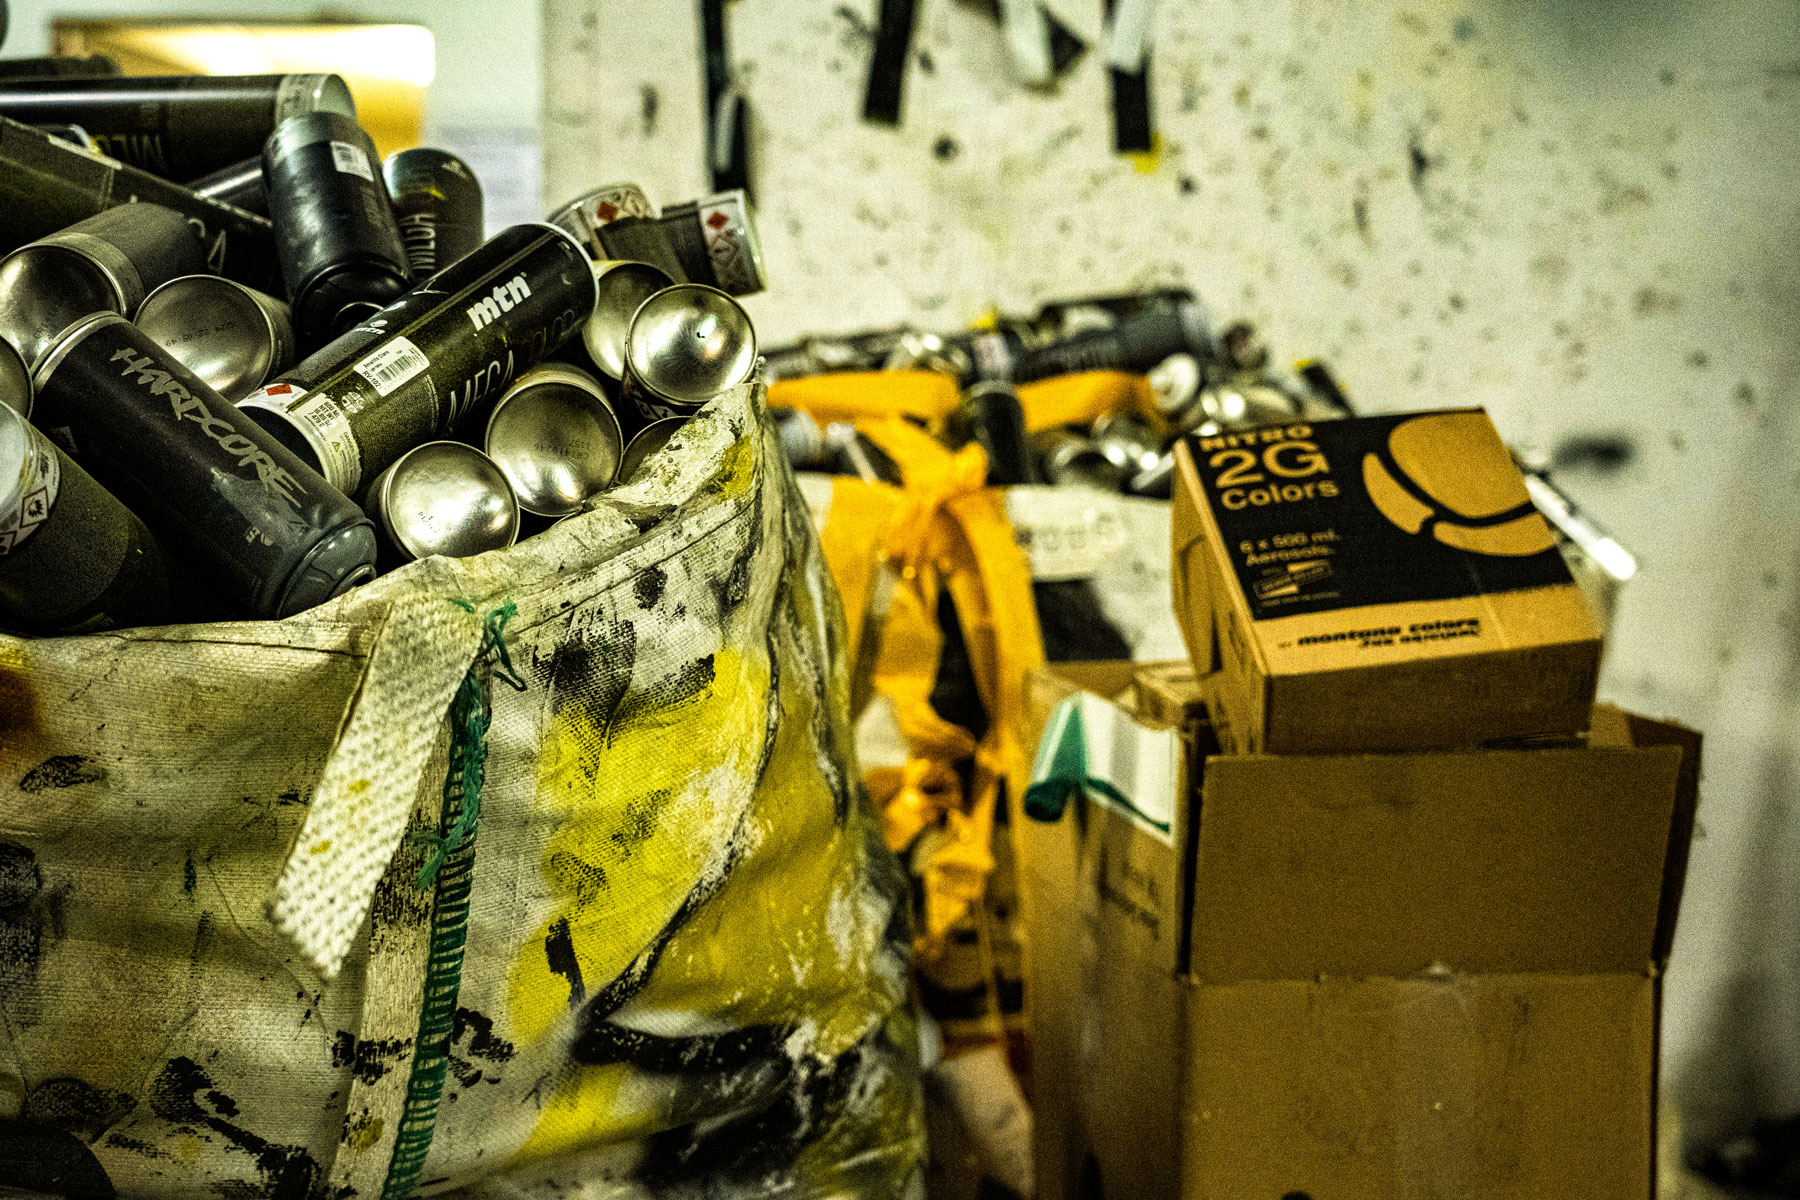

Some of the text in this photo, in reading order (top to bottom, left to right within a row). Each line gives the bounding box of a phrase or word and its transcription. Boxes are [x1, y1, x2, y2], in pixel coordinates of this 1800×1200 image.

[466, 272, 532, 332] mtn
[109, 347, 308, 509] HARDCORE
[1208, 439, 1330, 489] 2G
[1220, 479, 1340, 511] Colors
